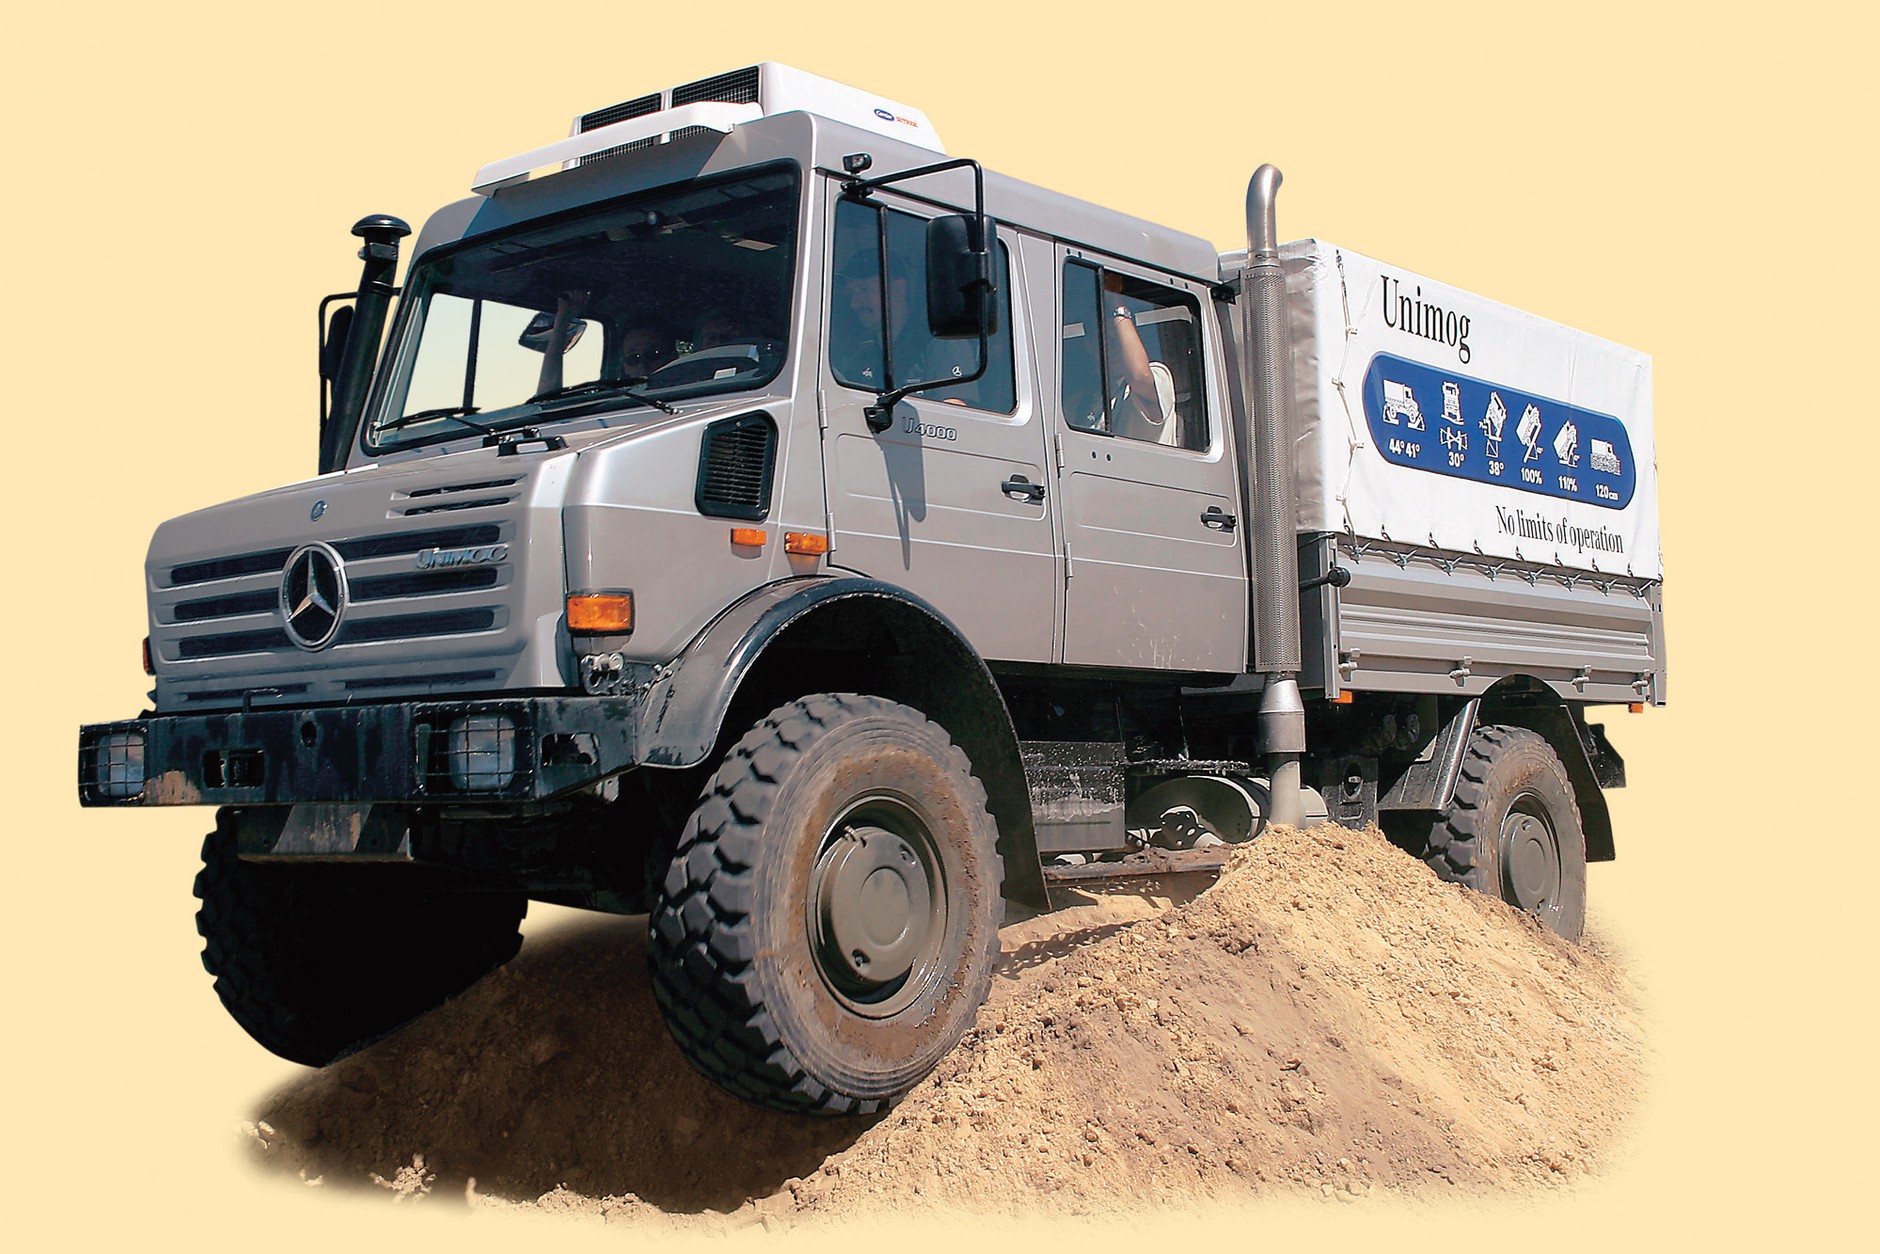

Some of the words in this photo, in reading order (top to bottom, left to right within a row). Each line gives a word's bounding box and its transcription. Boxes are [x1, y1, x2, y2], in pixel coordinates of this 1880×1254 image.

[1380, 274, 1471, 364] Unimog
[1448, 451, 1465, 467] 30°
[1488, 460, 1504, 476] 38°
[1521, 467, 1543, 485] 100%
[1558, 475, 1578, 492] 110%
[1495, 505, 1515, 536] No
[1516, 509, 1554, 542] limits
[1556, 517, 1568, 544] of
[1569, 525, 1624, 554] operation
